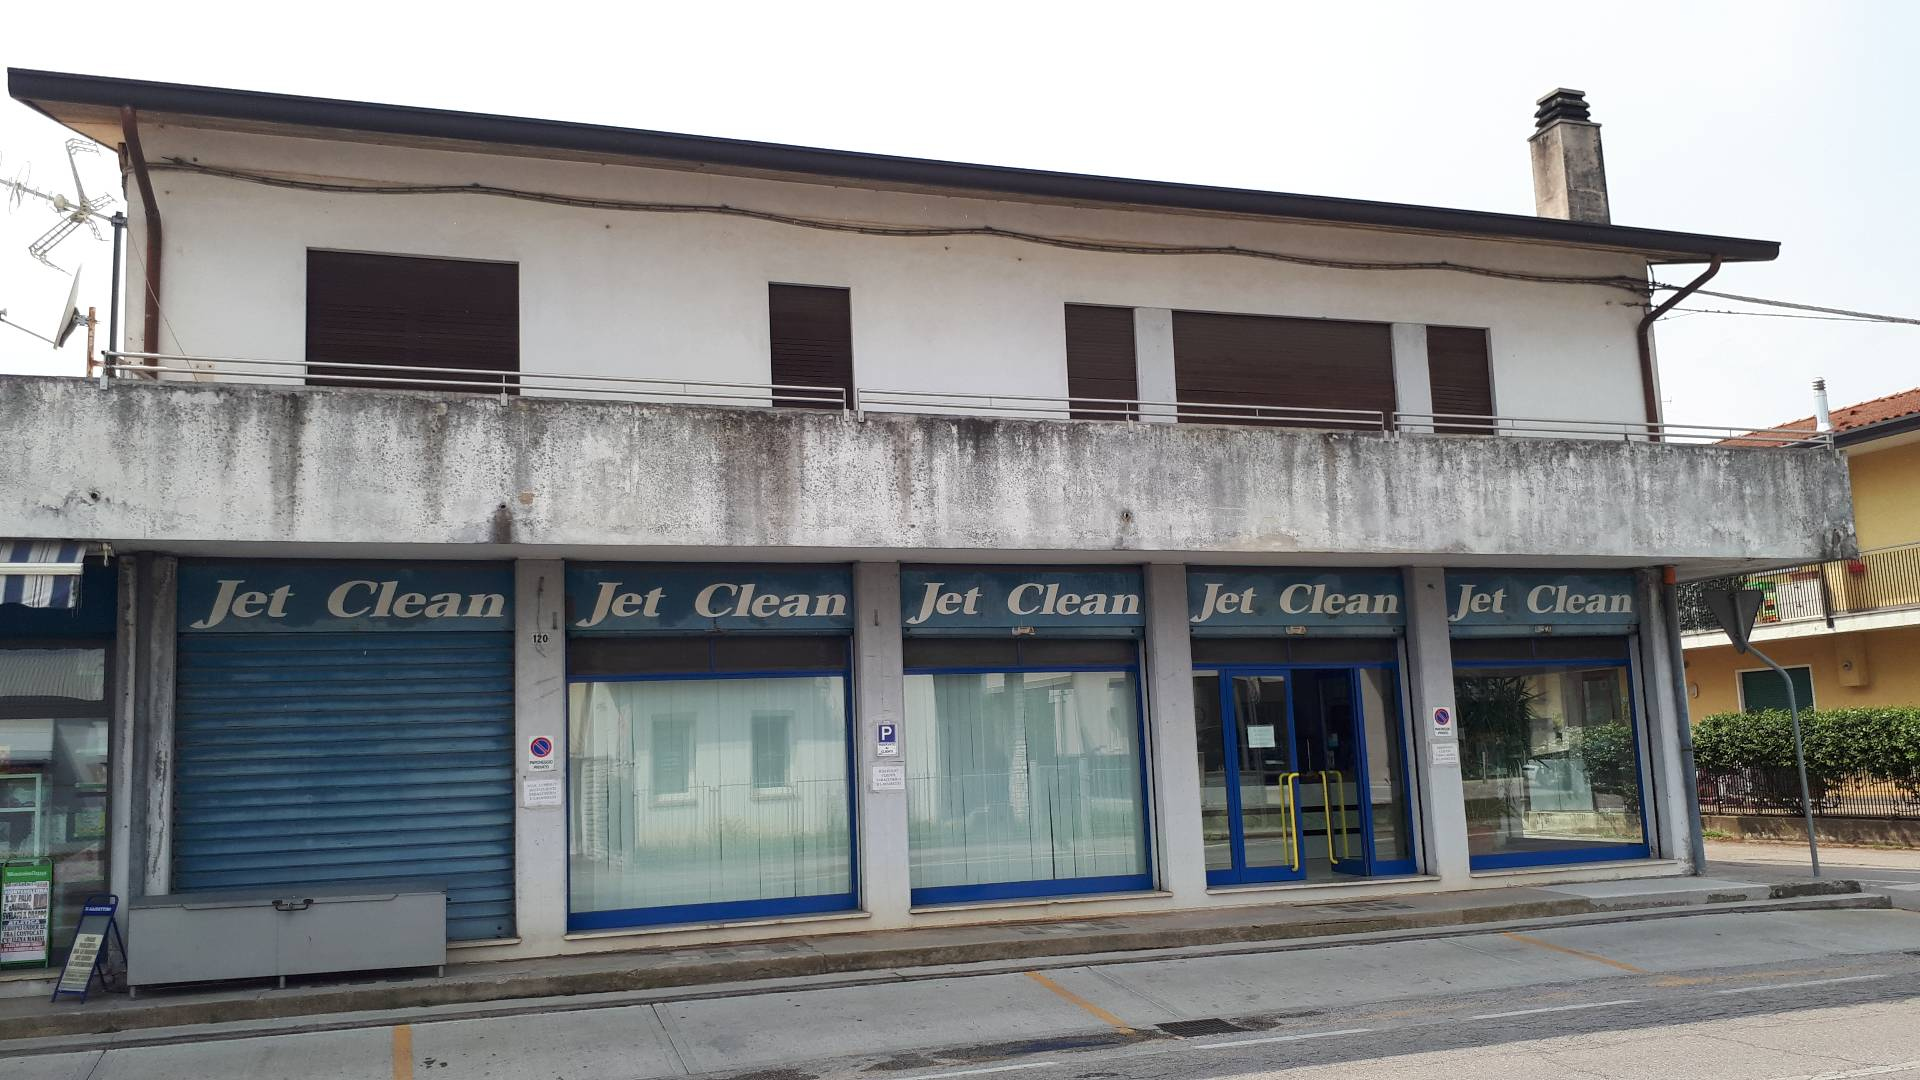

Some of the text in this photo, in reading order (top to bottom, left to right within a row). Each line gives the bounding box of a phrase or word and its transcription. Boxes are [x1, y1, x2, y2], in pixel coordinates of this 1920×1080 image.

[190, 579, 505, 629] Jet Clean
[576, 582, 847, 628] Jet Clean
[905, 582, 1140, 625] Jet Clean
[1190, 583, 1400, 623] Jet Clean
[1448, 584, 1633, 622] Jet Clean
[533, 634, 548, 643] 120
[881, 726, 892, 741] P
